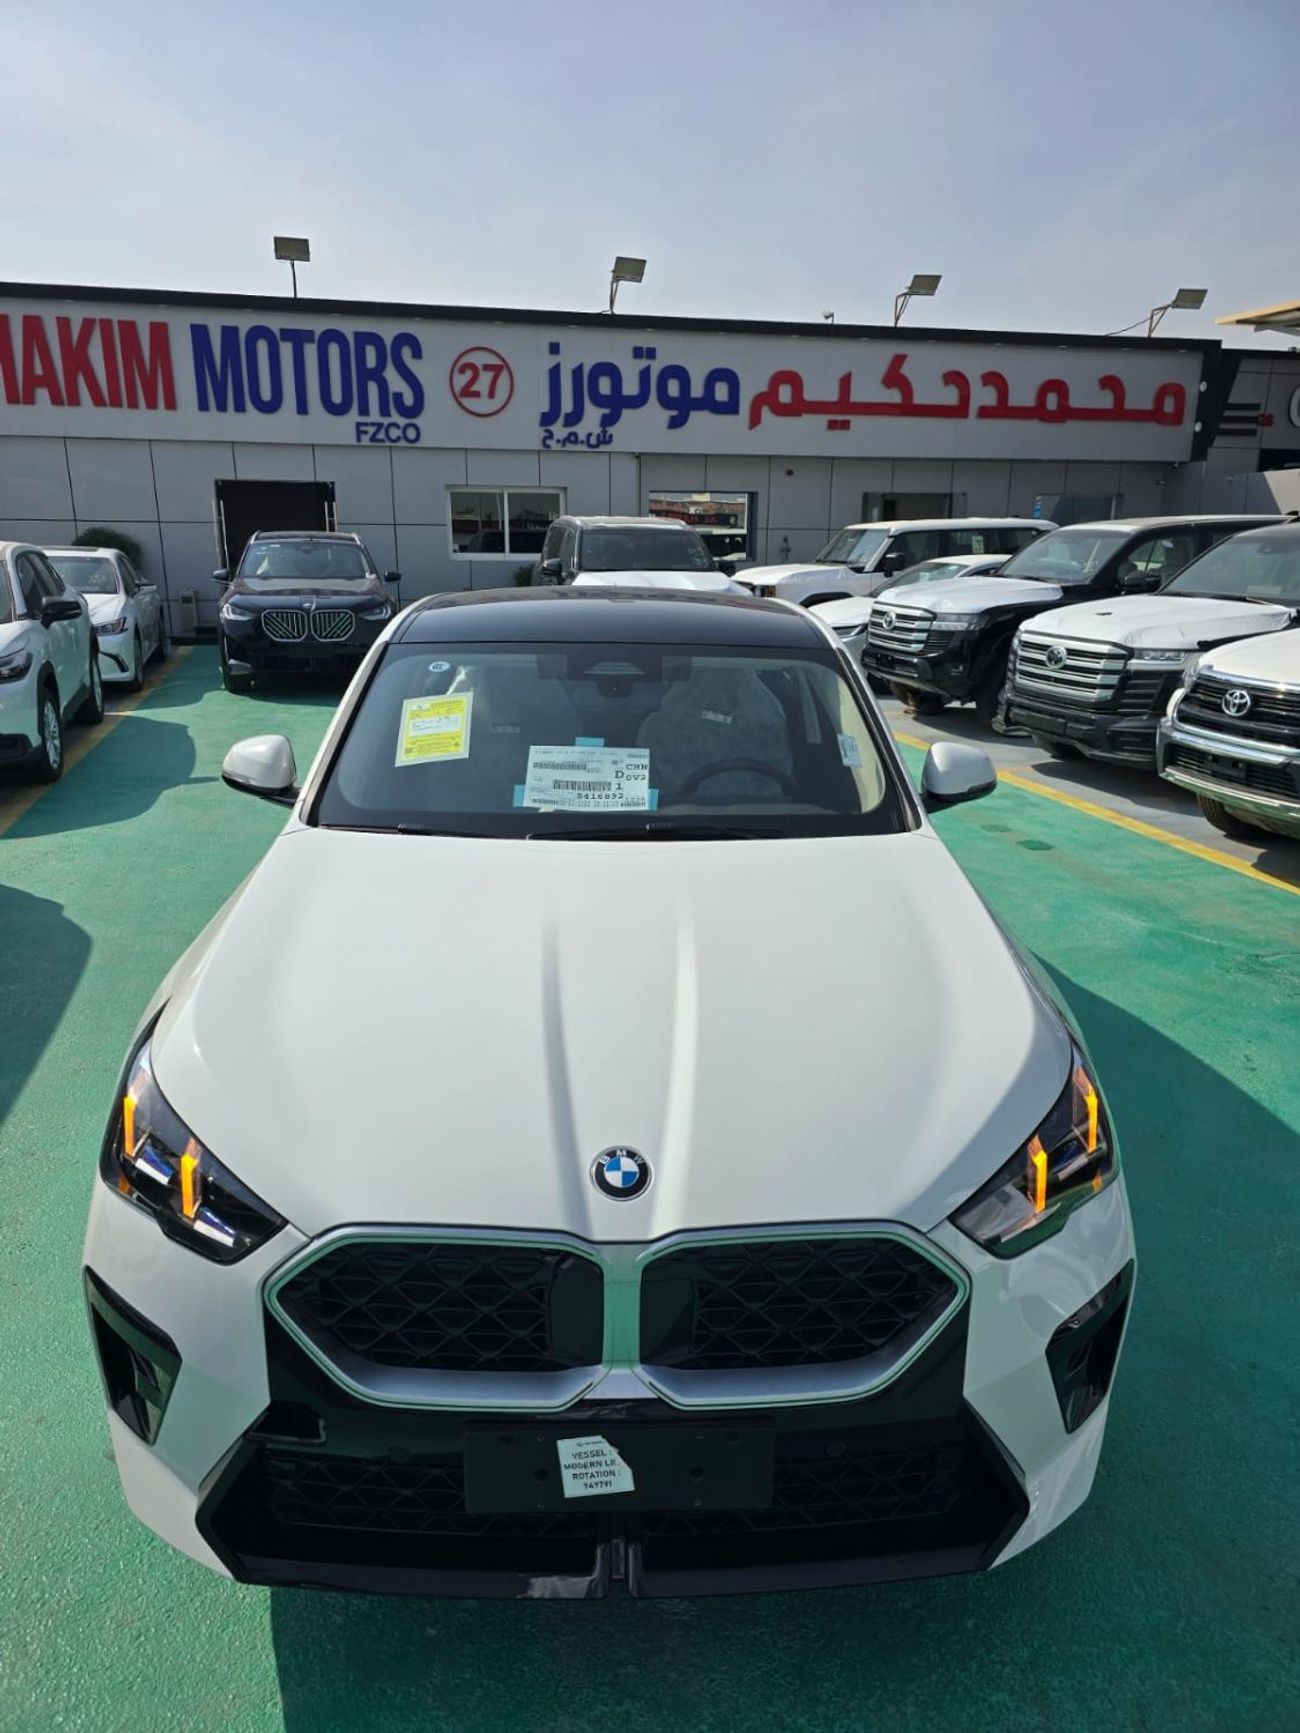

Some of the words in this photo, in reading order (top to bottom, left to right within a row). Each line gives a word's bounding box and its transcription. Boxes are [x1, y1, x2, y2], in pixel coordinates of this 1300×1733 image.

[189, 323, 425, 419] MOTORS
[457, 362, 505, 399] 27
[539, 342, 741, 430] موتورز
[355, 422, 421, 444] FZCO
[615, 770, 625, 779] D
[572, 1449, 607, 1460] VESSEL
[564, 1461, 602, 1470] MODERN
[572, 1470, 616, 1480] ROTATION
